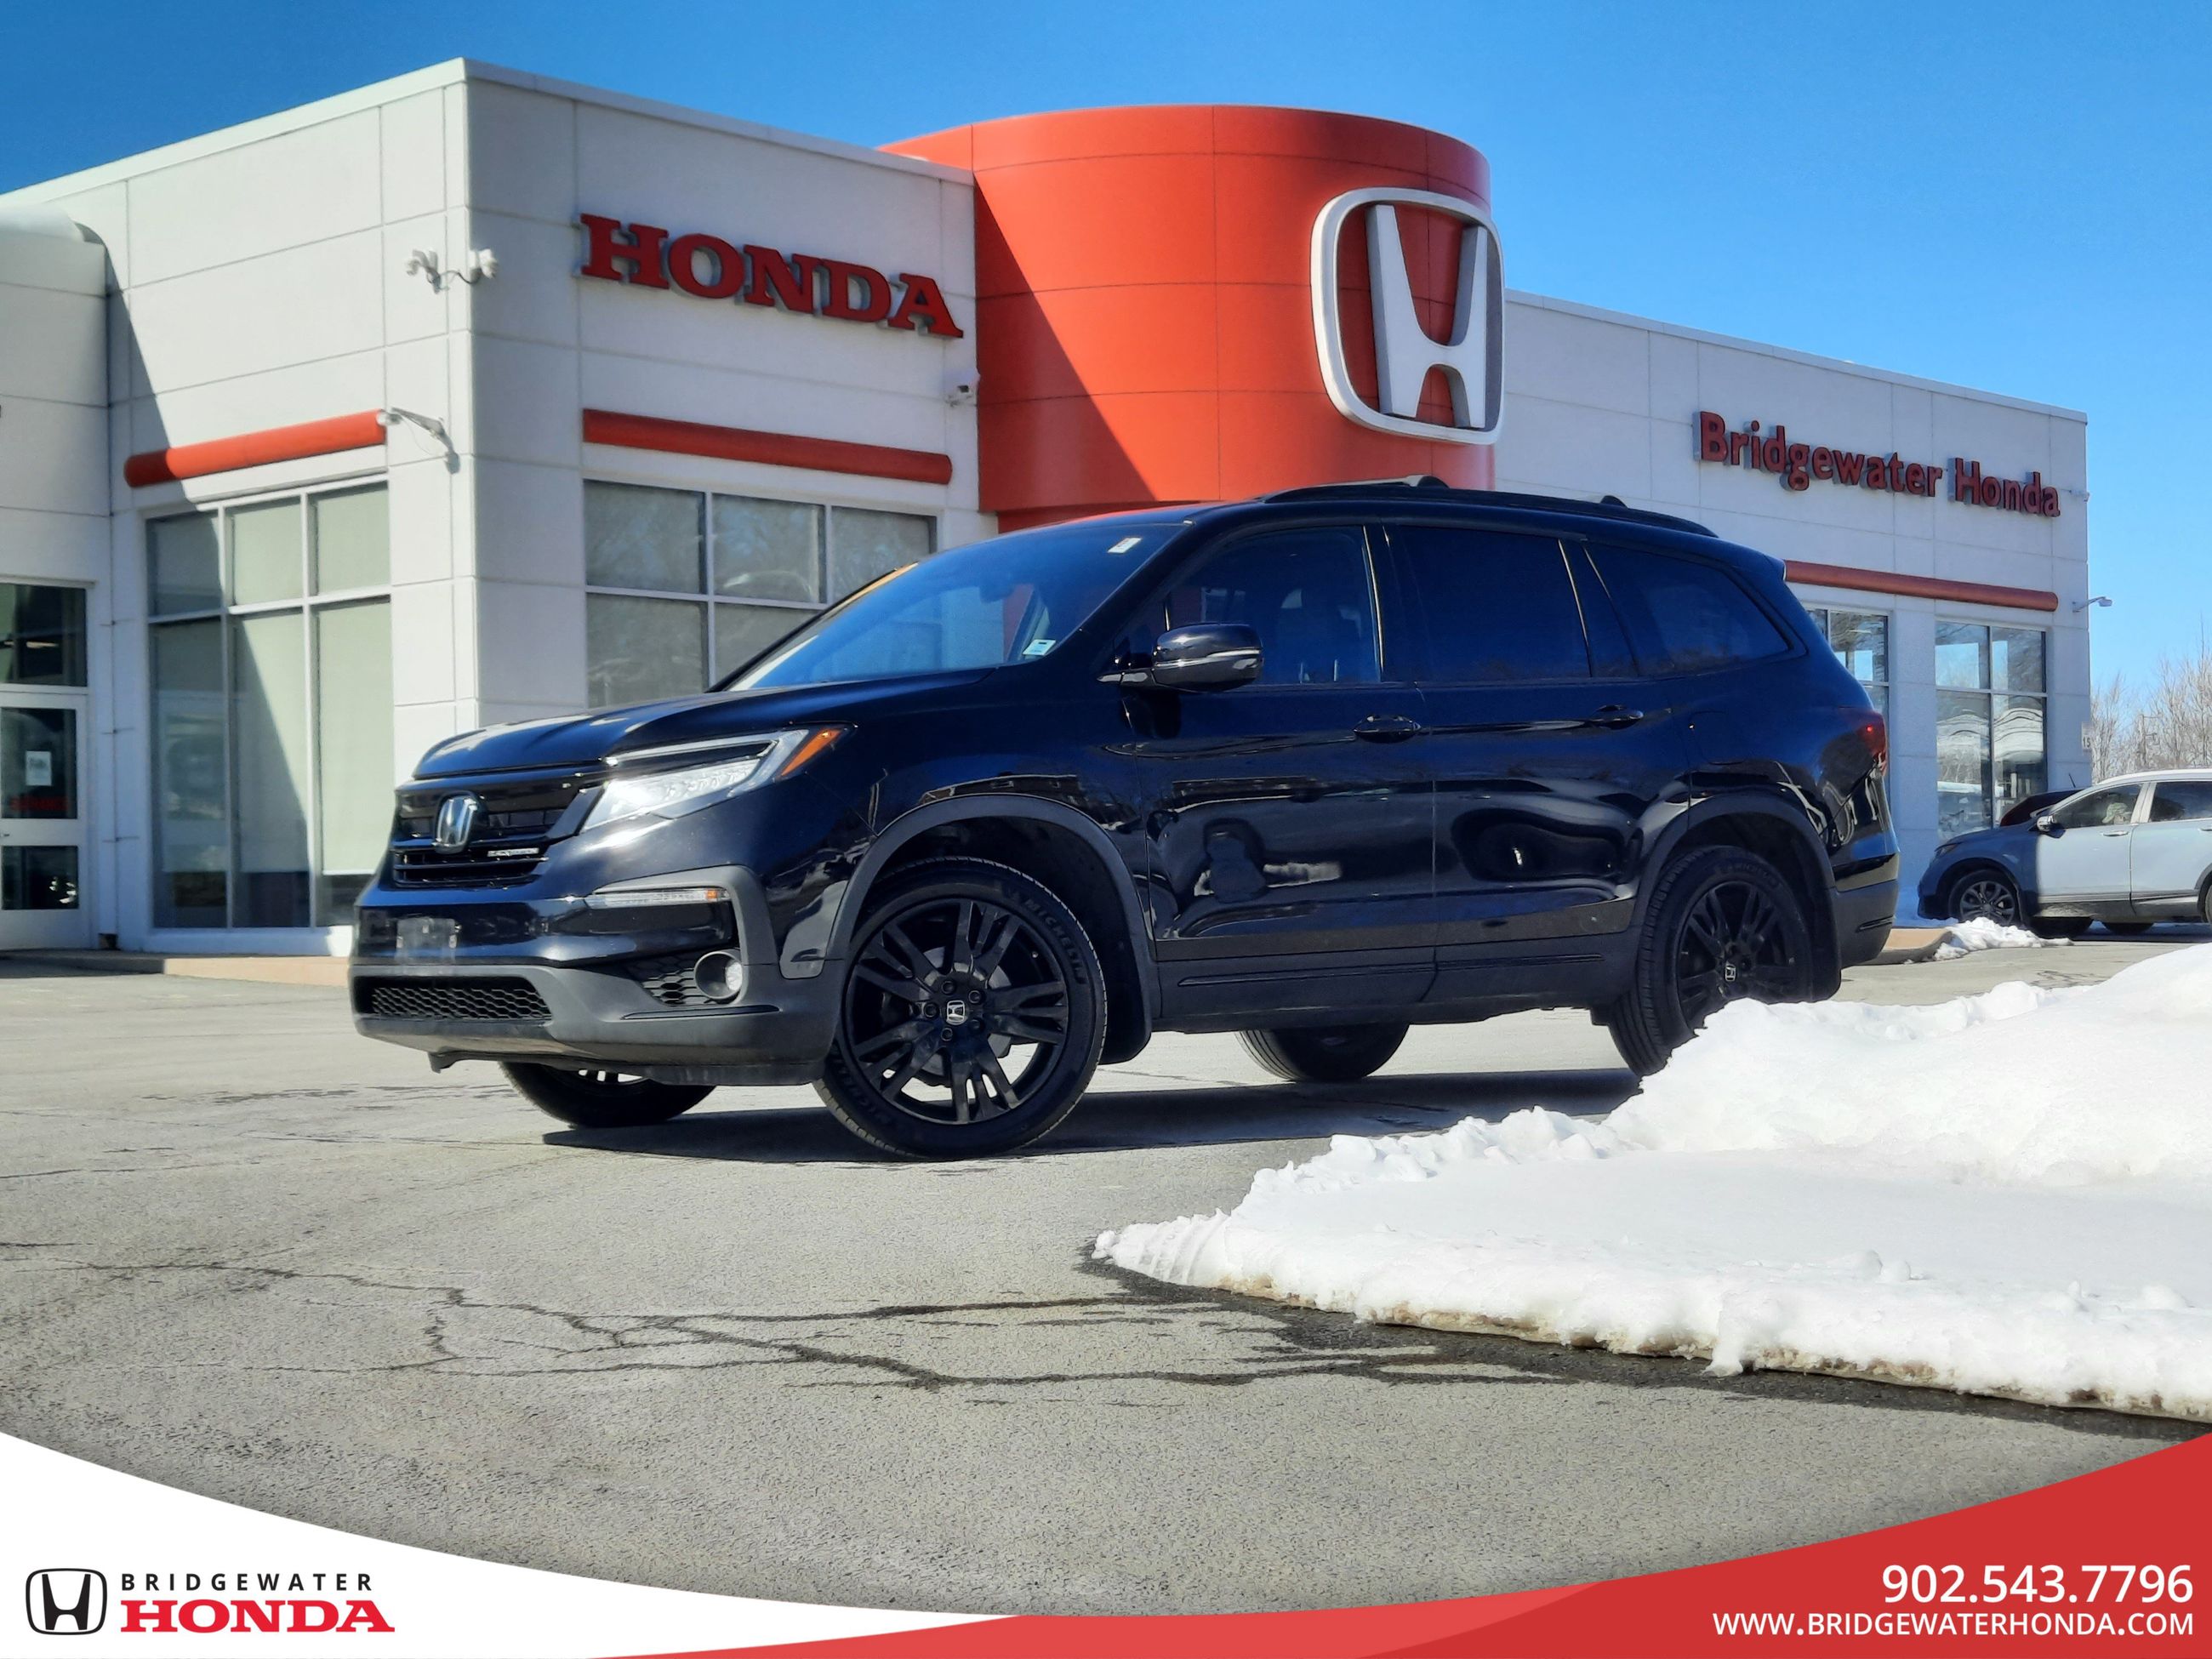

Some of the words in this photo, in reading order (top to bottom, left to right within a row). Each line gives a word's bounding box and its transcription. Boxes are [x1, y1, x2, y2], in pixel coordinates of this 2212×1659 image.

[579, 213, 964, 339] HONDA
[1696, 410, 1943, 498] Bridgewater
[1953, 457, 2061, 517] Honda
